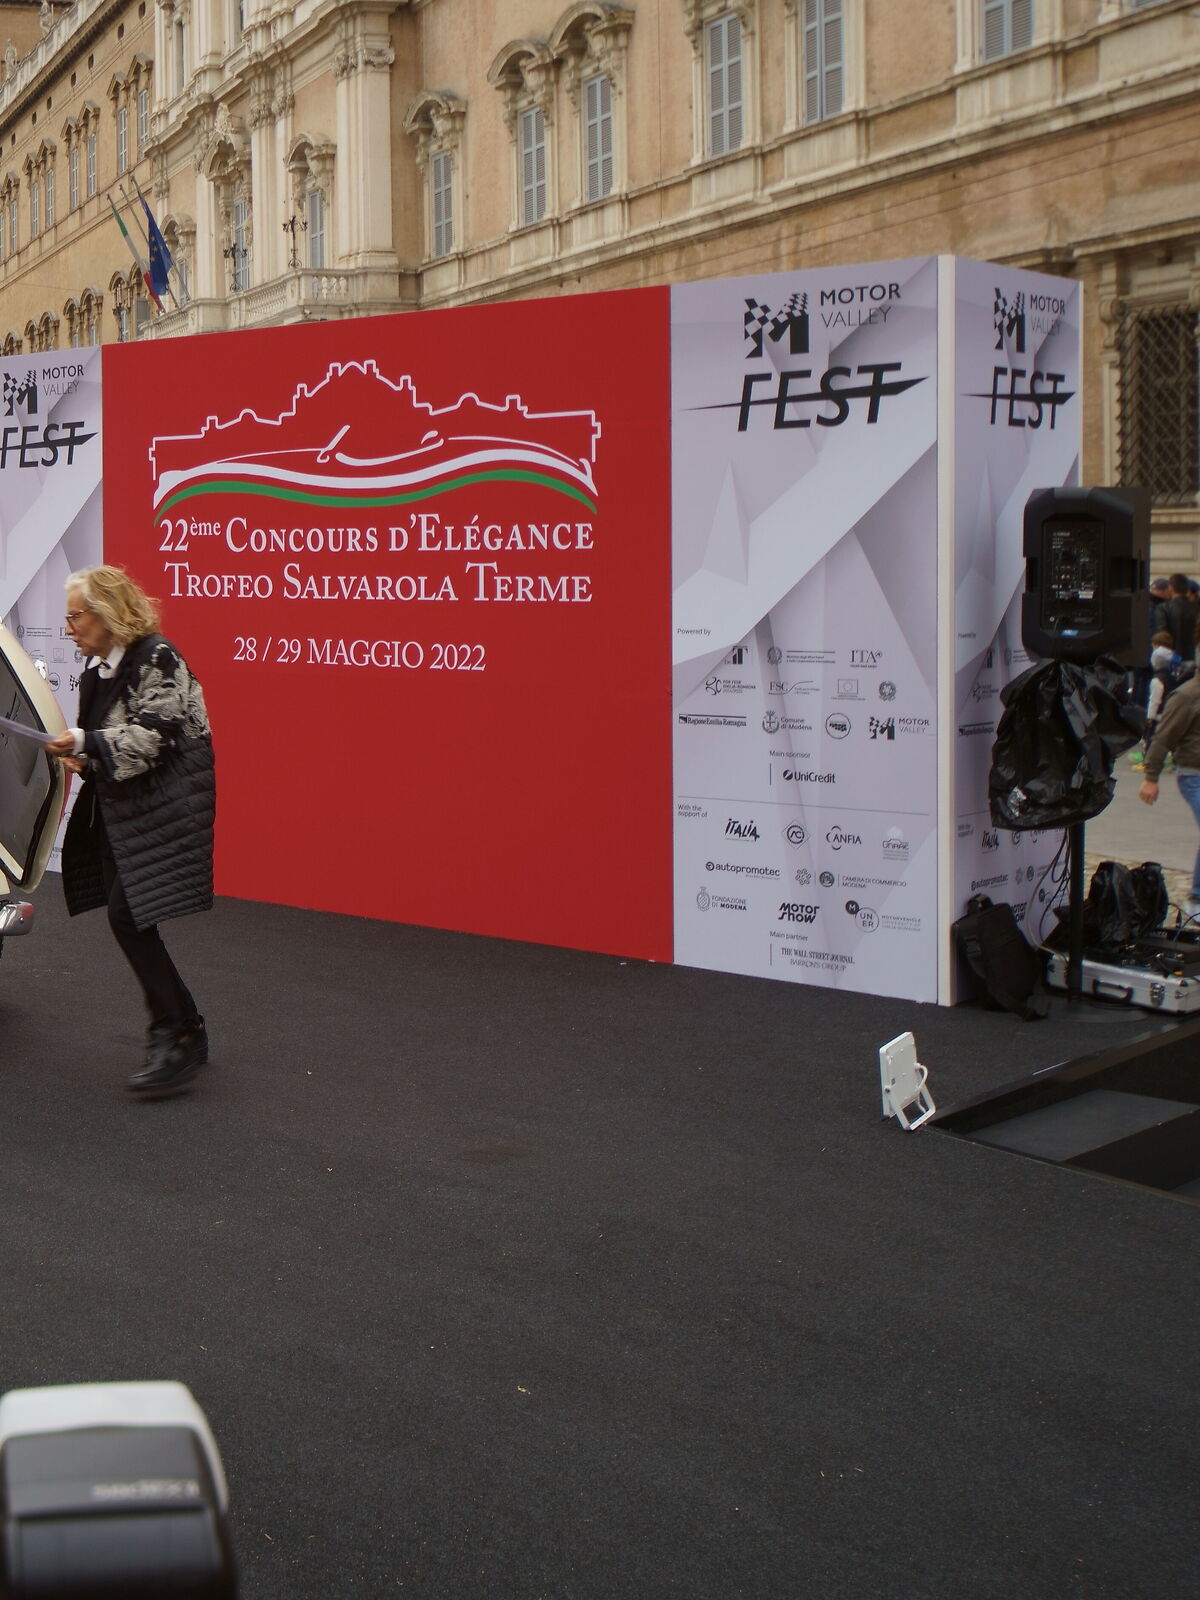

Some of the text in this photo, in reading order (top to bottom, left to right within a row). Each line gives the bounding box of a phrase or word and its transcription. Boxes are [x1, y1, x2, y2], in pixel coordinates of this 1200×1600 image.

[820, 282, 901, 306] MOTOR
[1030, 293, 1066, 315] MOTOR
[821, 306, 892, 328] VALLEY
[1030, 315, 1062, 336] VALLEY
[42, 364, 85, 380] MOTOR
[43, 380, 80, 396] VALLEY
[737, 361, 903, 431] FEST
[990, 366, 1066, 430] FEST
[0, 421, 86, 469] FEST
[158, 517, 221, 553] 22ème
[226, 517, 379, 553] CONCOURS
[164, 561, 594, 602] TROFEO SALVAROLA TERME
[233, 636, 257, 663] 28
[277, 637, 302, 665] 29
[307, 638, 425, 670] MAGGIO
[429, 643, 487, 672] 2022
[898, 718, 930, 726] MOTOR
[785, 751, 811, 759] sponsor
[794, 772, 836, 784] UniCredit
[715, 863, 781, 877] autopromotec
[770, 930, 809, 942] Main partner
[781, 947, 793, 956] THE
[793, 949, 808, 958] WALL
[809, 951, 830, 961] STREET
